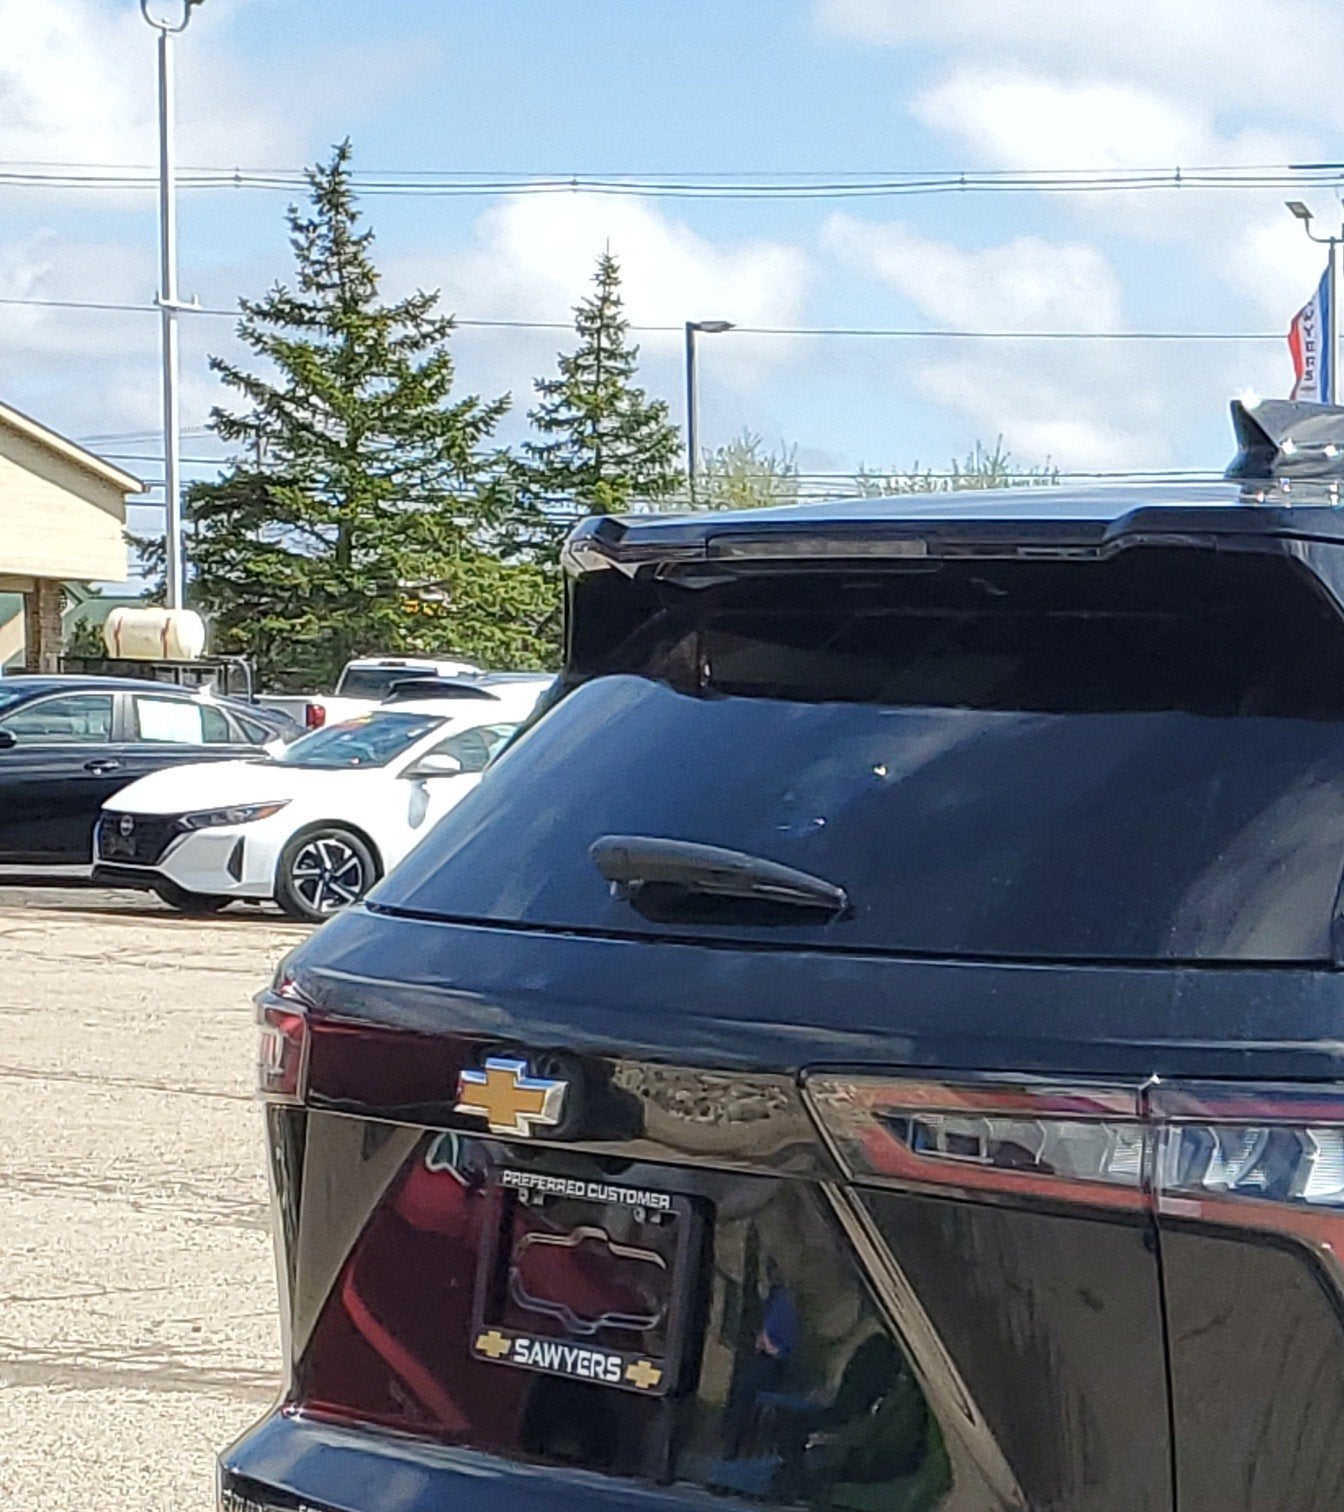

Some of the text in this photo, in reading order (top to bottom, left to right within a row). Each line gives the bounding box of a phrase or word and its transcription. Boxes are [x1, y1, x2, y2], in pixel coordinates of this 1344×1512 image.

[502, 1170, 670, 1209] PREFERRED CUSTOMER
[513, 1338, 622, 1382] SAWYERS
